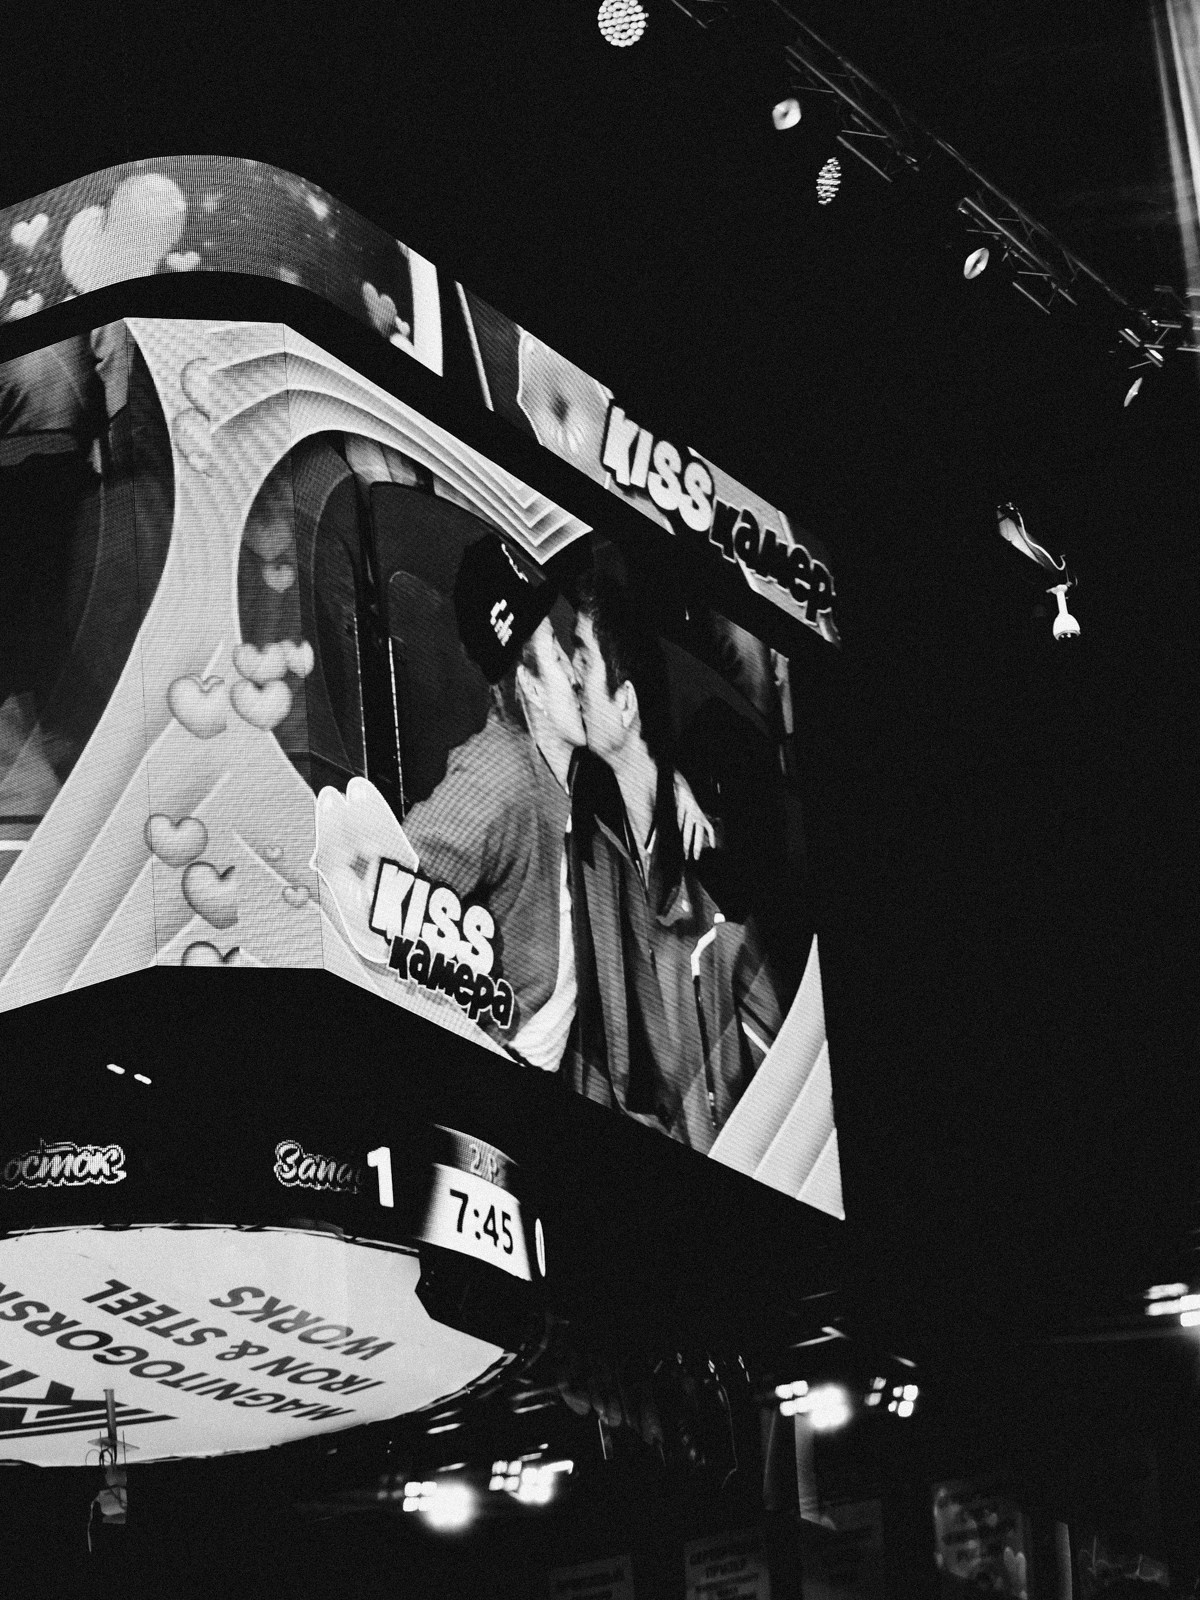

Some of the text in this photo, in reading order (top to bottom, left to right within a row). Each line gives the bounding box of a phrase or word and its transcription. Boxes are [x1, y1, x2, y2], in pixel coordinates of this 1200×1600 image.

[602, 404, 837, 628] KISS камер
[371, 862, 496, 978] KISS
[387, 935, 515, 1029] камера
[366, 1146, 395, 1208] 1
[449, 1188, 514, 1255] 7:45
[81, 1278, 387, 1396] IRON & STEEL
[208, 1285, 398, 1361] WORKS
